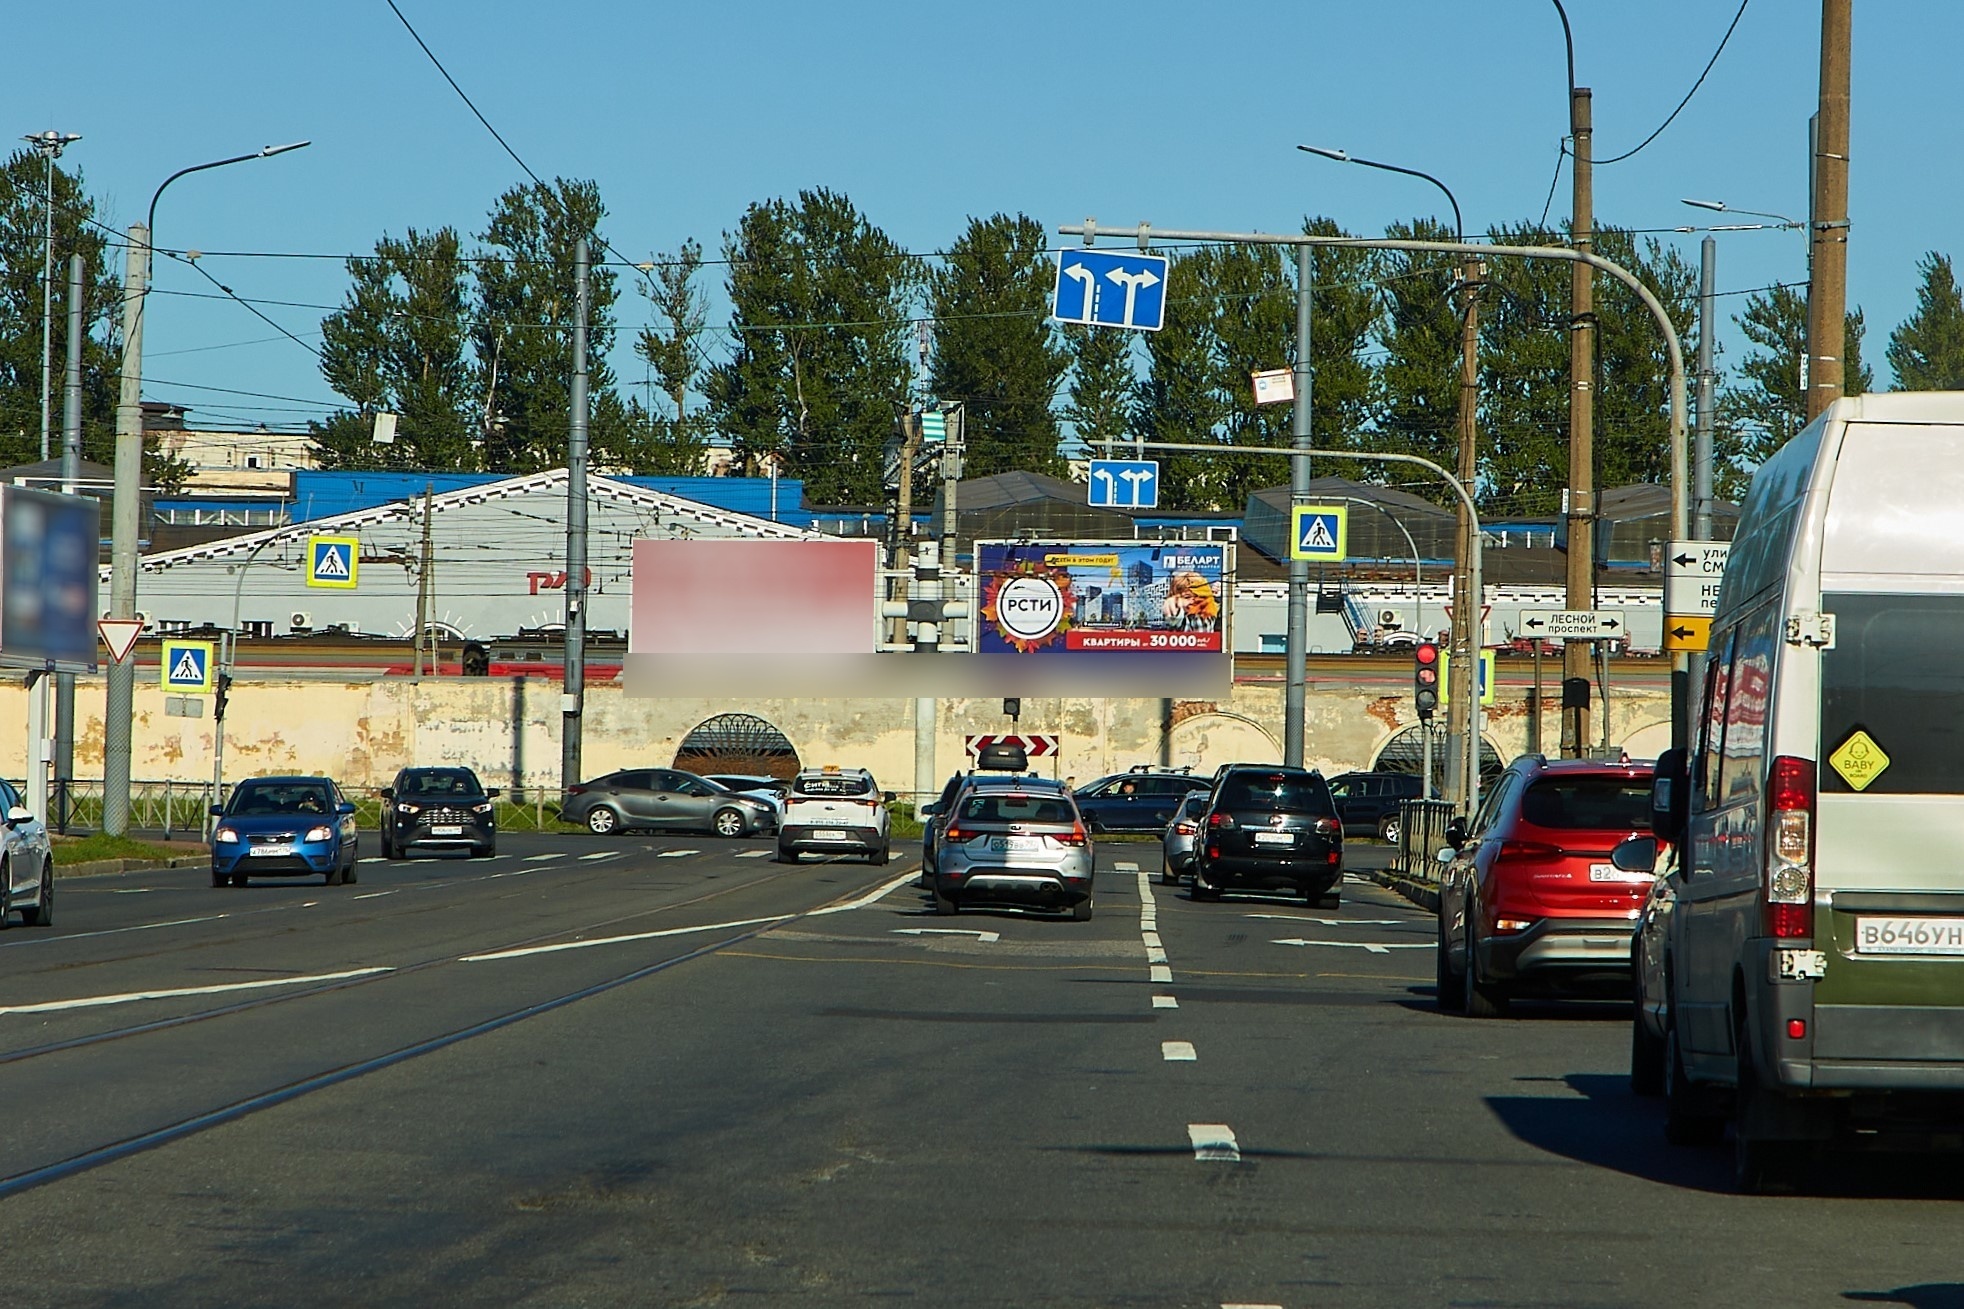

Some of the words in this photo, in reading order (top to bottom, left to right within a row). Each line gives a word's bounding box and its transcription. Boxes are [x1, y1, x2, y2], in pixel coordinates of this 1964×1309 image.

[1703, 549, 1728, 560] ули
[1177, 556, 1220, 565] БЕЛАРТ
[1703, 561, 1725, 573] СМ
[1701, 585, 1721, 596] НЕ
[1008, 599, 1051, 611] РСТИ
[1701, 599, 1718, 608] пе
[1550, 613, 1595, 623] ЛЕСНОЙ
[1548, 625, 1598, 634] проспект
[1083, 638, 1140, 647] КВАРТИРЫ
[1150, 635, 1168, 647] 30
[1169, 635, 1197, 647] 000
[1844, 760, 1875, 770] BABY
[1865, 921, 1962, 945] В646УН
